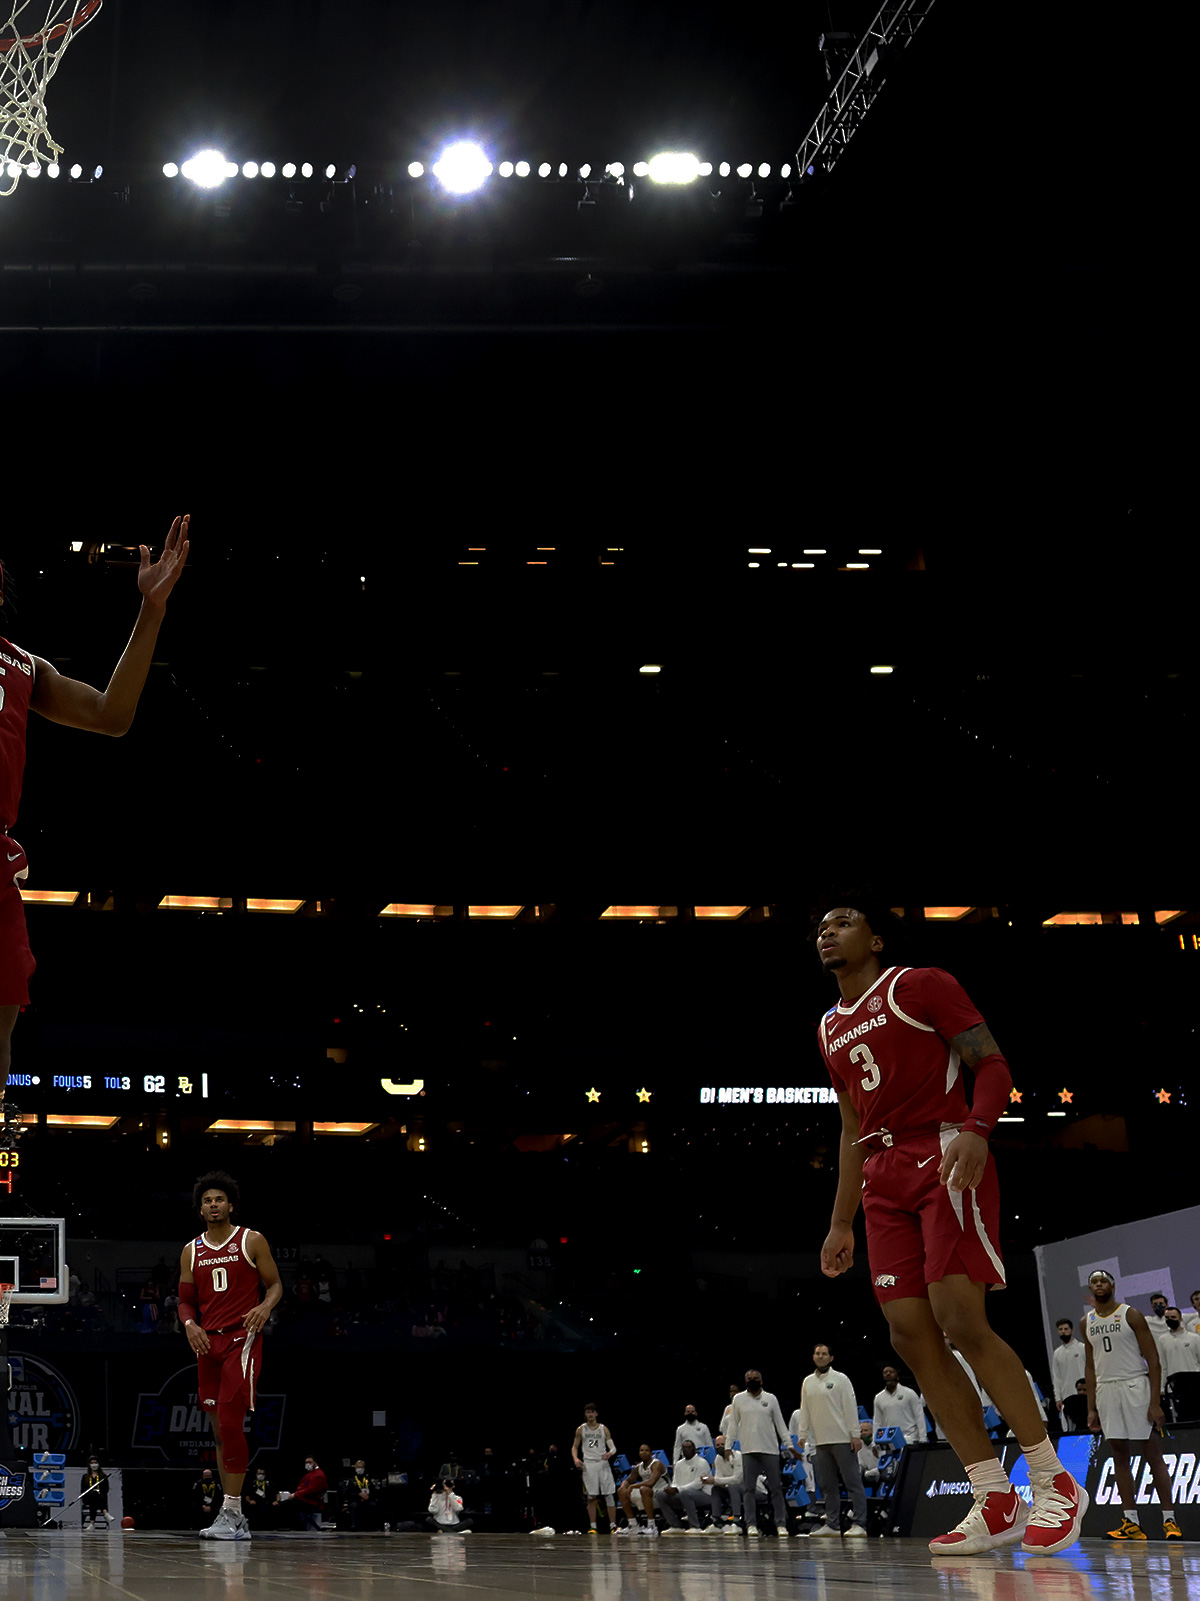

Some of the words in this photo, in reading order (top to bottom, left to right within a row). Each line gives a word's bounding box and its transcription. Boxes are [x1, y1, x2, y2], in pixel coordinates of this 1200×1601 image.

[828, 1013, 887, 1056] ARKANSAS
[849, 1042, 882, 1092] 3
[6, 1074, 31, 1086] ONUS
[143, 1075, 166, 1093] 62
[718, 1087, 764, 1104] MEN'S
[198, 1255, 239, 1267] ARKANSAS
[276, 1247, 297, 1259] 137
[211, 1267, 228, 1292] 0
[1090, 1323, 1121, 1336] BAYLOR
[1103, 1336, 1112, 1353] 0
[169, 1405, 252, 1432] DAE
[588, 1439, 599, 1449] 24
[938, 1480, 971, 1495] Invesco
